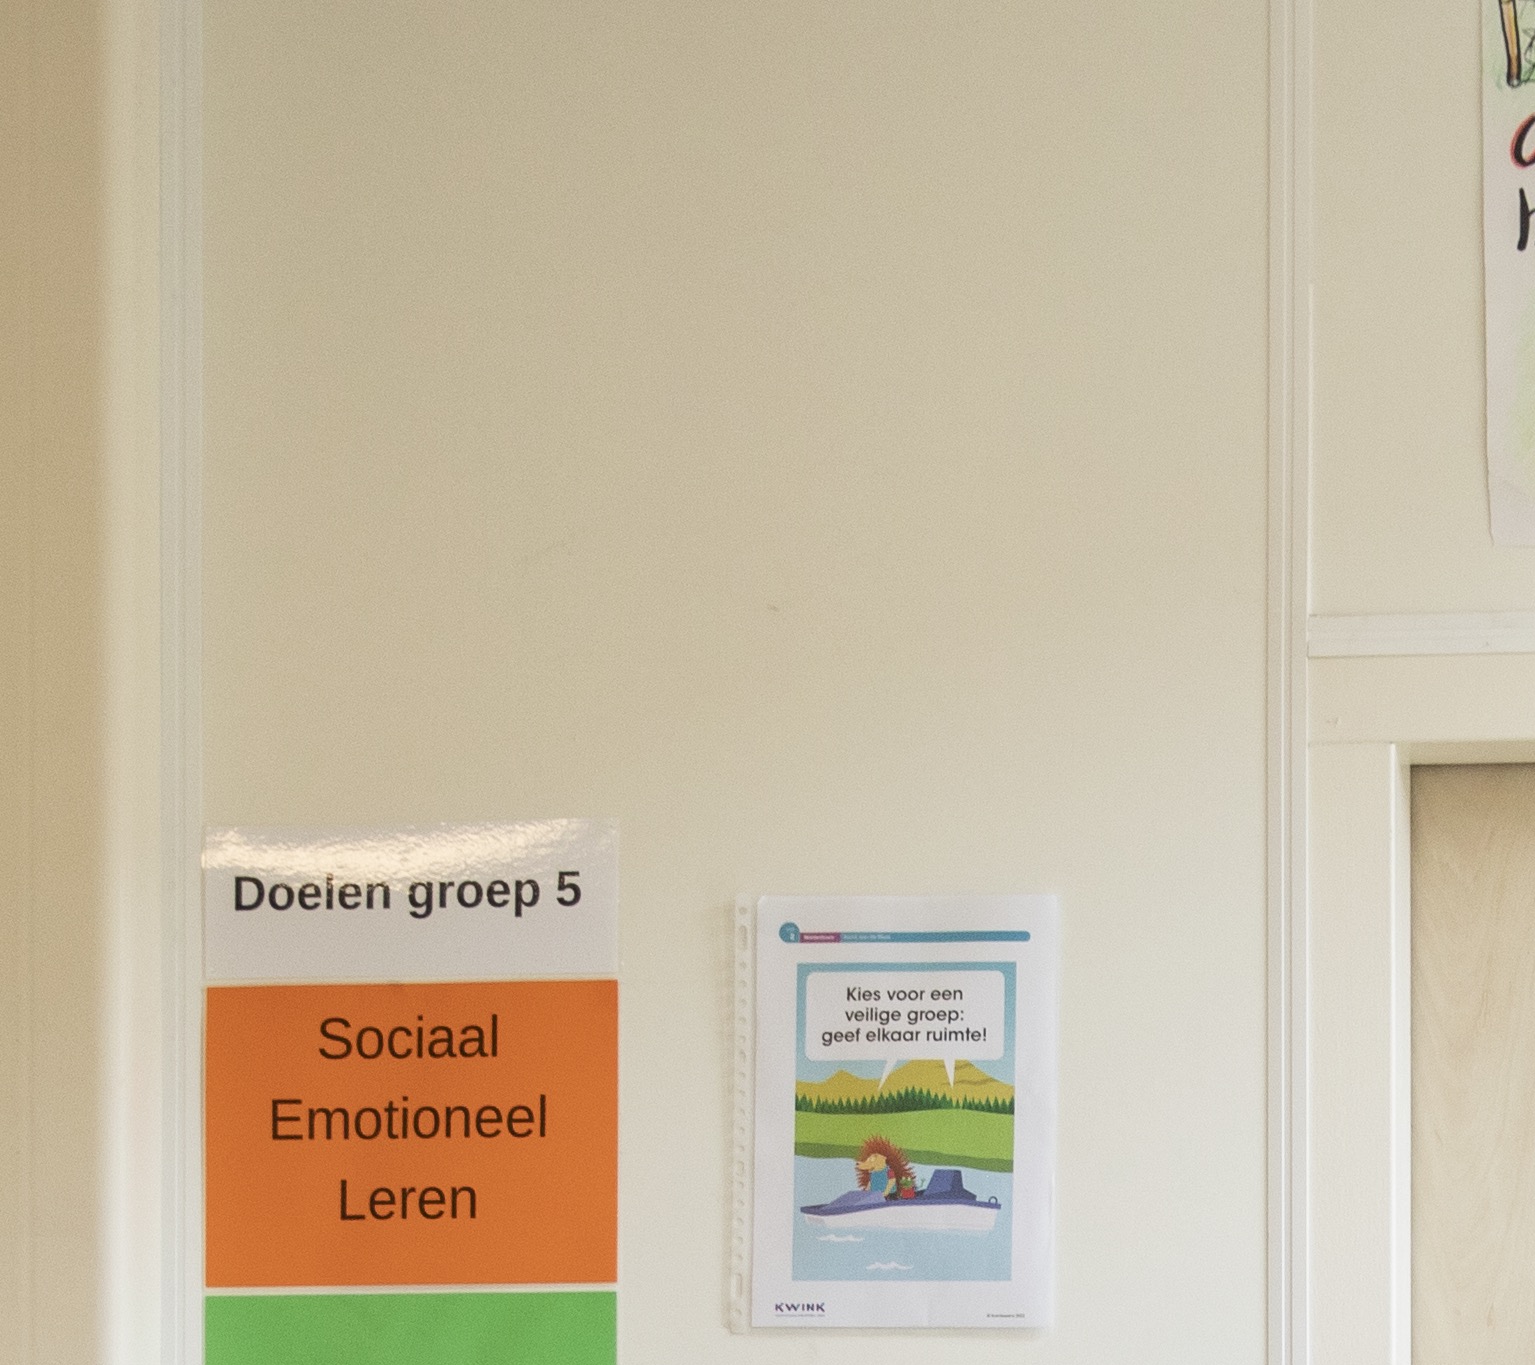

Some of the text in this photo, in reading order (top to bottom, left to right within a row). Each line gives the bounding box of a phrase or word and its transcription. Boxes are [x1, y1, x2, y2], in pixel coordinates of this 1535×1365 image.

[234, 870, 581, 919] Doelen groep 5
[845, 986, 963, 1001] Kies voor een
[844, 1007, 964, 1026] veilige groep:
[318, 1014, 498, 1060] Sociaal
[821, 1027, 987, 1047] geef elkaar ruimte!
[271, 1095, 546, 1140] Emotioneel
[339, 1179, 476, 1220] Leren
[774, 1302, 825, 1312] KWINK
